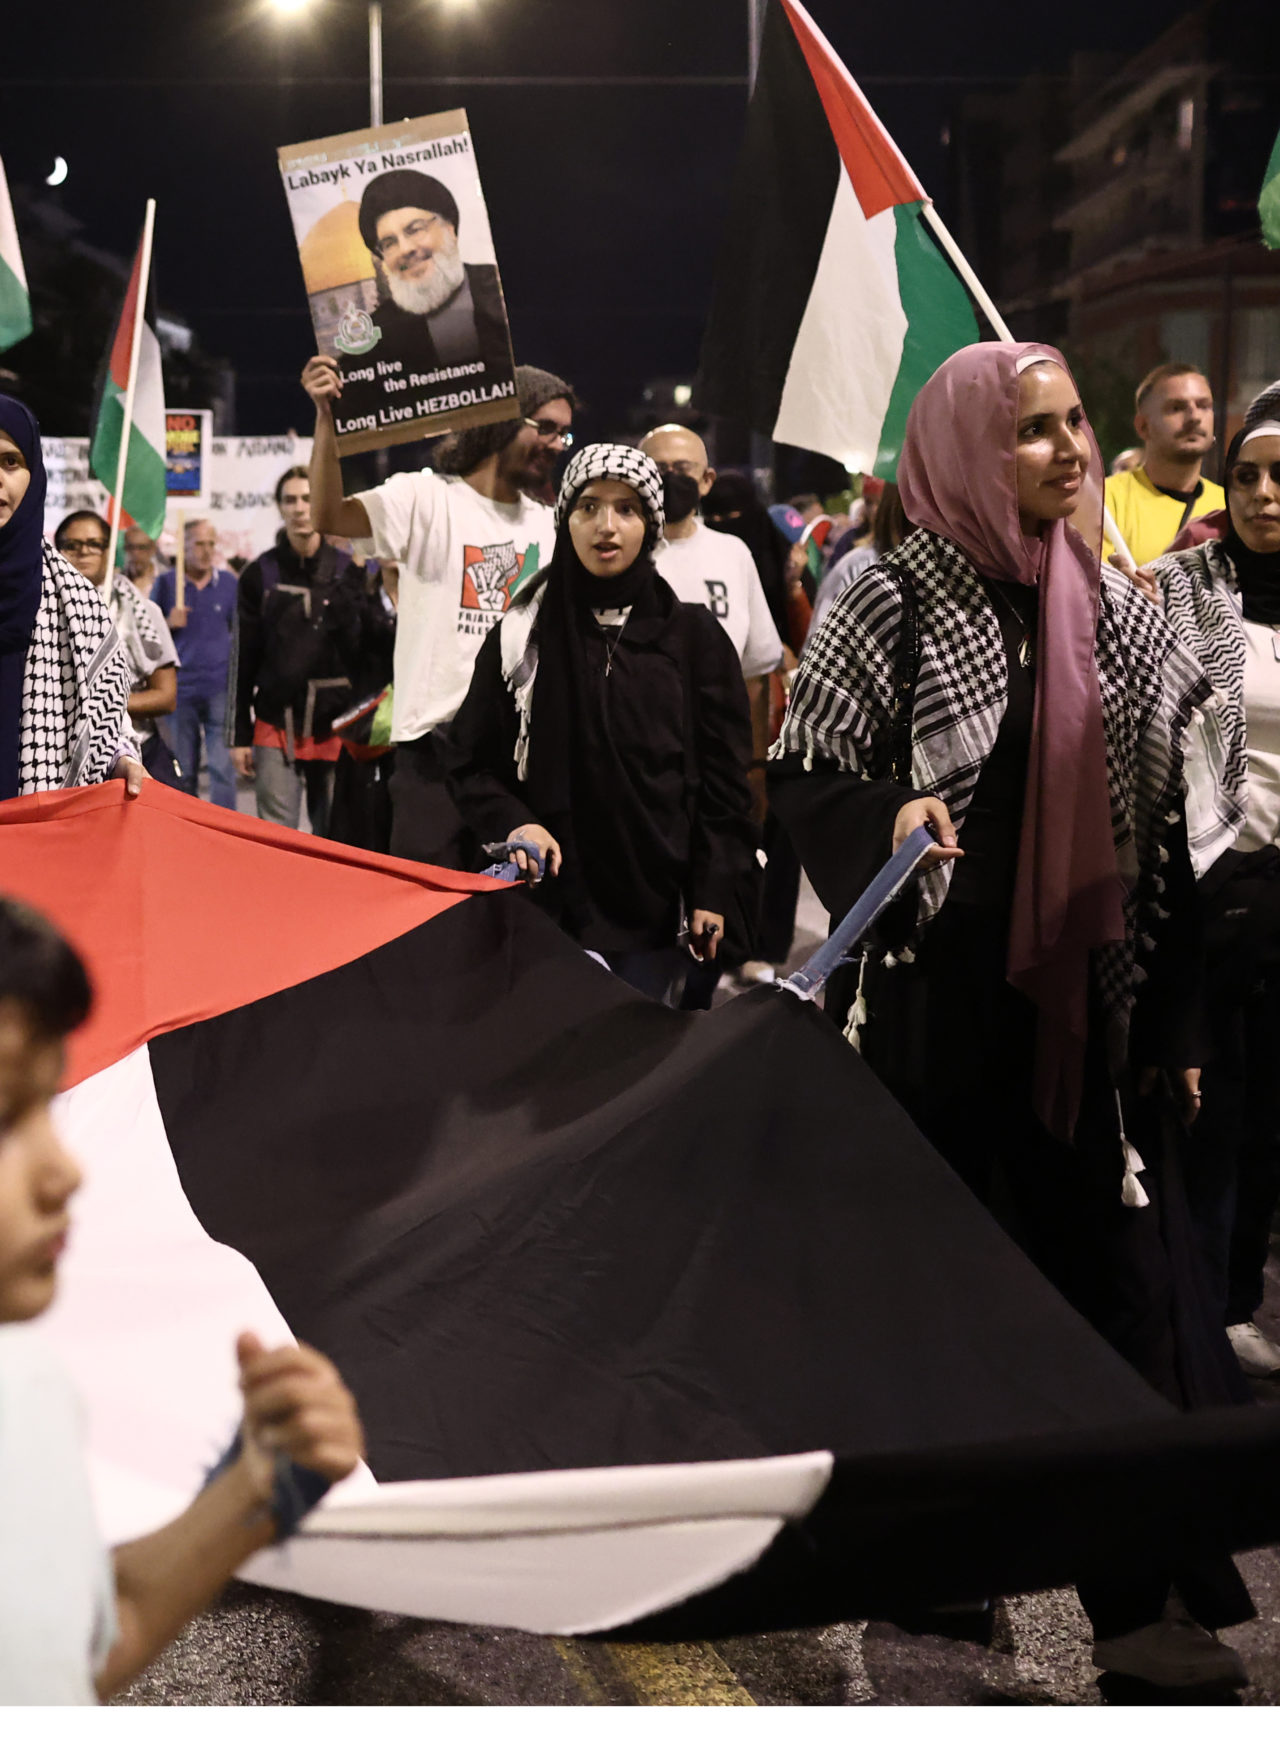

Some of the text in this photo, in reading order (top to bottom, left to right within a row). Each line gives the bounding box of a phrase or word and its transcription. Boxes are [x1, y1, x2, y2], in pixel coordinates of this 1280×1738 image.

[287, 138, 470, 191] Labayk Ya Nasrallah!
[340, 361, 403, 384] Long live
[383, 361, 486, 393] the Resistance
[336, 381, 516, 434] Long Live HEZBOLLAH
